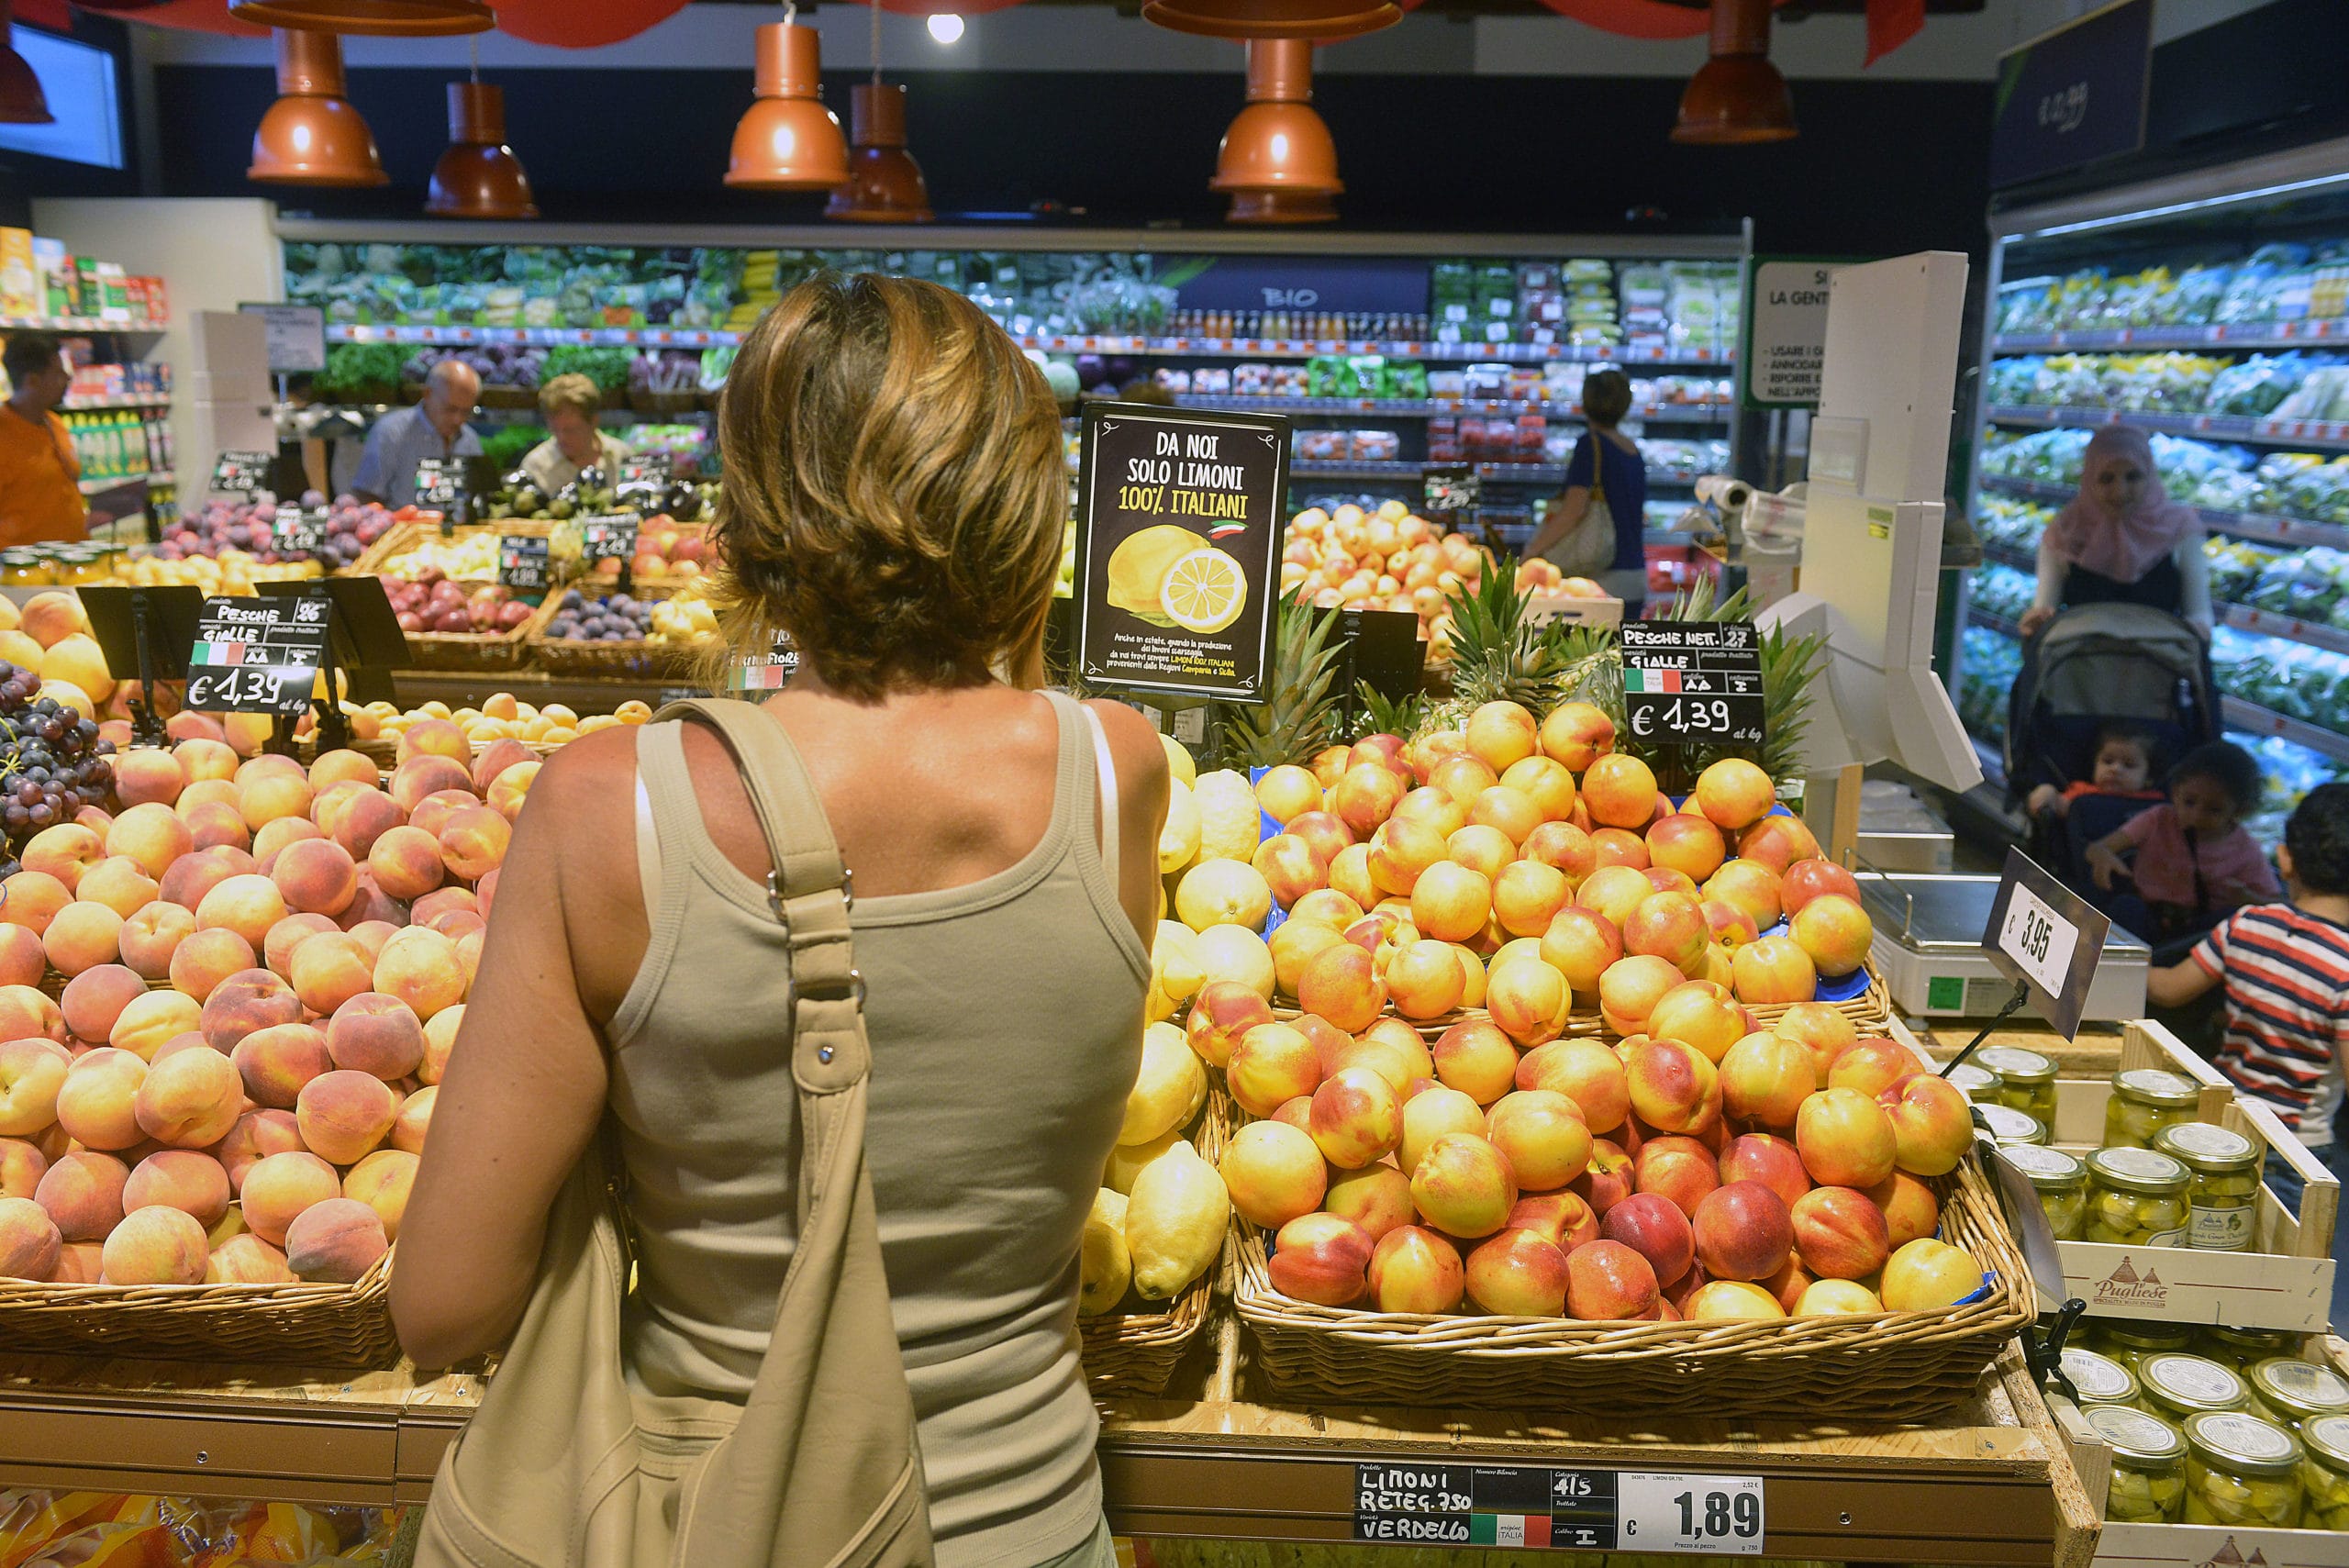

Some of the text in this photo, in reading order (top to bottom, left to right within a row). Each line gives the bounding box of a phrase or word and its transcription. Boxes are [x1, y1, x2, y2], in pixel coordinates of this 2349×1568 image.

[1261, 287, 1319, 307] BIO
[1770, 291, 1830, 306] LA GENT
[1156, 431, 1219, 461] DA NOI
[1127, 458, 1244, 491] SOLO LIMONI
[1119, 485, 1249, 520] 100% ITALIANI
[217, 605, 281, 624] PESCHE
[203, 626, 260, 643] GIALLE
[1114, 632, 1135, 643] Anche
[1167, 639, 1189, 649] quando
[1197, 640, 1232, 651] produzione
[1623, 629, 1682, 645] PESCHE
[1724, 630, 1748, 648] 27
[245, 652, 269, 664] AA
[1107, 660, 1142, 669] provenienti
[1158, 662, 1181, 673] Regioni
[1182, 664, 1211, 675] Campania
[1109, 650, 1119, 658] da
[1130, 651, 1146, 661] trovi
[1147, 654, 1170, 664] sempre
[1170, 656, 1193, 664] LIMONI
[1208, 658, 1235, 668] ITALIANI
[1631, 655, 1688, 670] GIALLE
[188, 667, 284, 706] € 1,39
[1631, 698, 1731, 736] € 1,39
[1732, 727, 1763, 743] al kg
[2021, 909, 2053, 963] 3,95
[2094, 1280, 2168, 1299] Pugliese
[1362, 1470, 1447, 1491] LIMONI
[1438, 1492, 1472, 1512] 750
[1674, 1491, 1760, 1540] 1,89
[1364, 1518, 1469, 1541] VERDELLO
[1497, 1531, 1524, 1540] ITALIA
[1626, 1518, 1637, 1536] €
[1675, 1541, 1693, 1550] Prezzo
